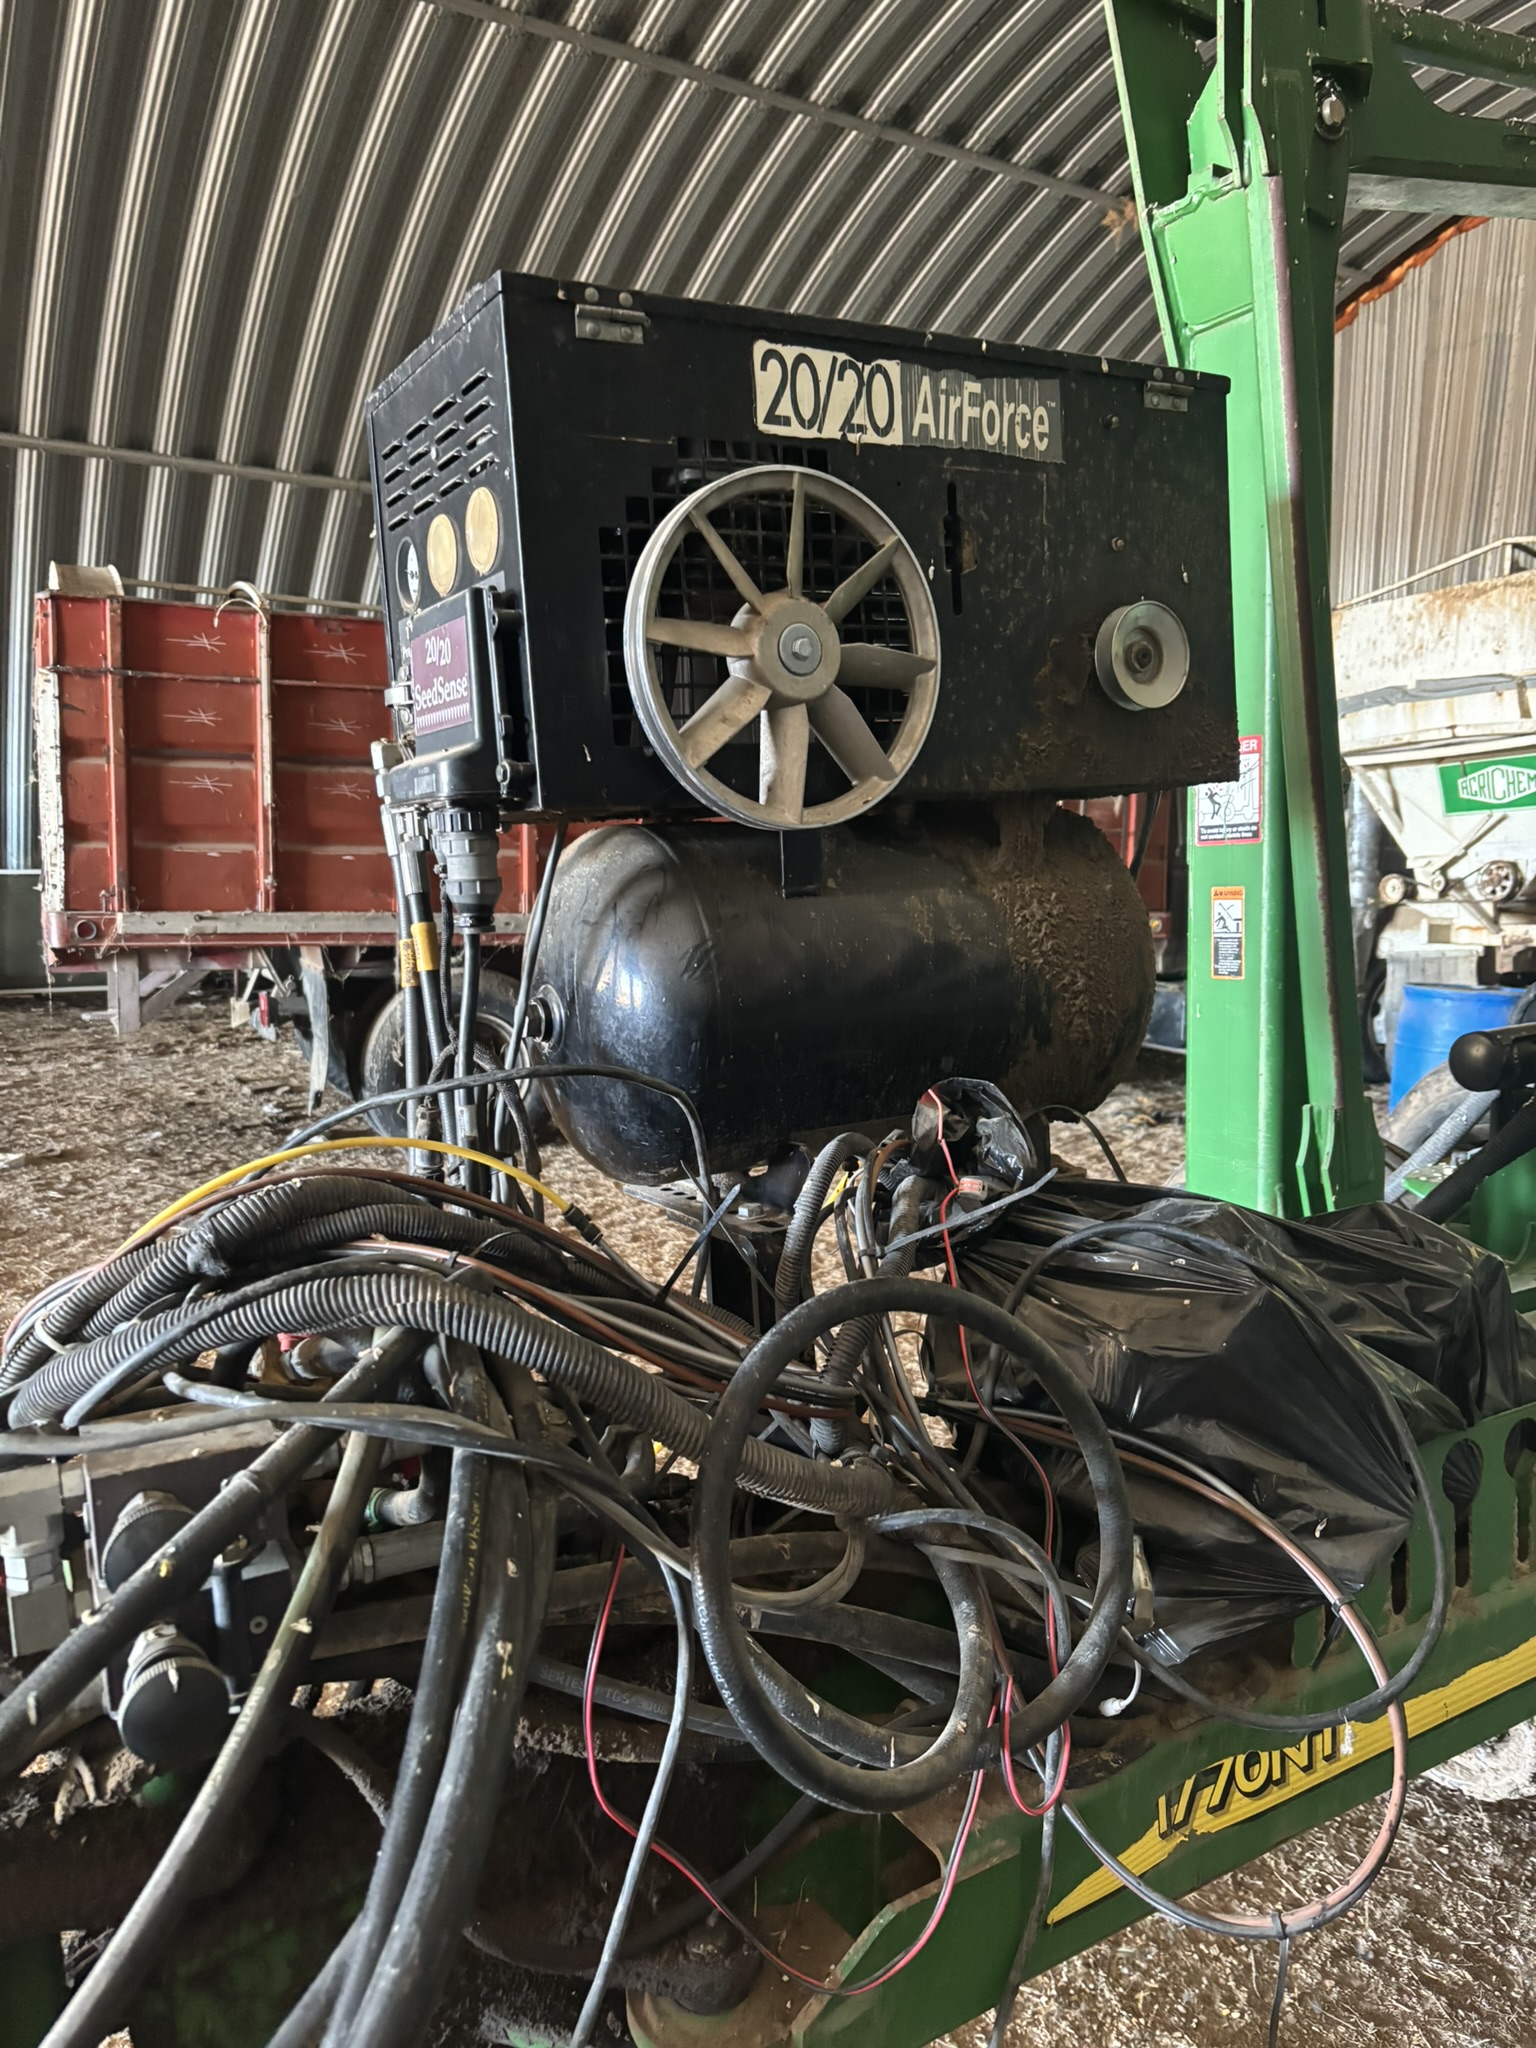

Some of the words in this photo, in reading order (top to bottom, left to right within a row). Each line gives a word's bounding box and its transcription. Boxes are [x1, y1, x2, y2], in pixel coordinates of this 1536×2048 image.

[760, 348, 895, 437] 20/20
[425, 635, 451, 667] 20/20
[415, 676, 468, 711] SeedSense
